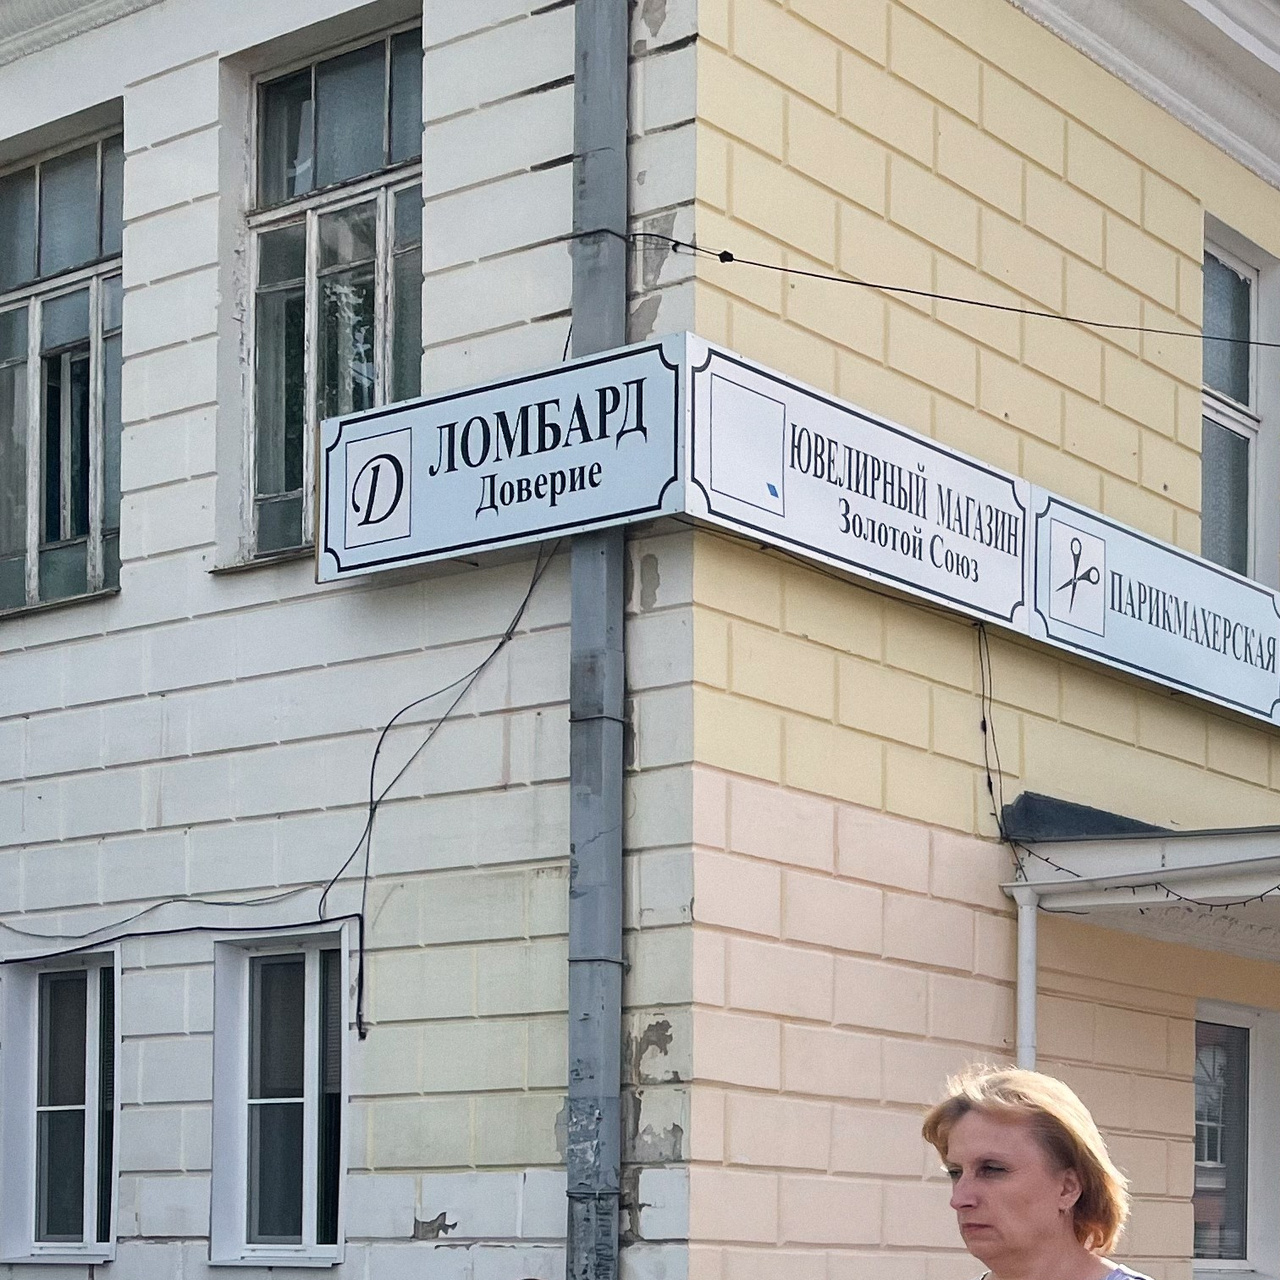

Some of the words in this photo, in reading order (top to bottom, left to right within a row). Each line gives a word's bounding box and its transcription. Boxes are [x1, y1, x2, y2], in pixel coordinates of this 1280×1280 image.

[429, 377, 648, 477] ЛОМБАРД
[475, 461, 603, 519] Доверие
[789, 422, 928, 520] ЮВЕЛИРНЫЙ
[936, 483, 1020, 558] МАГАЗИН
[838, 498, 923, 561] Золотой
[929, 534, 979, 584] Союз
[1109, 569, 1277, 674] ПАРИКМАХЕРСКАЯ
